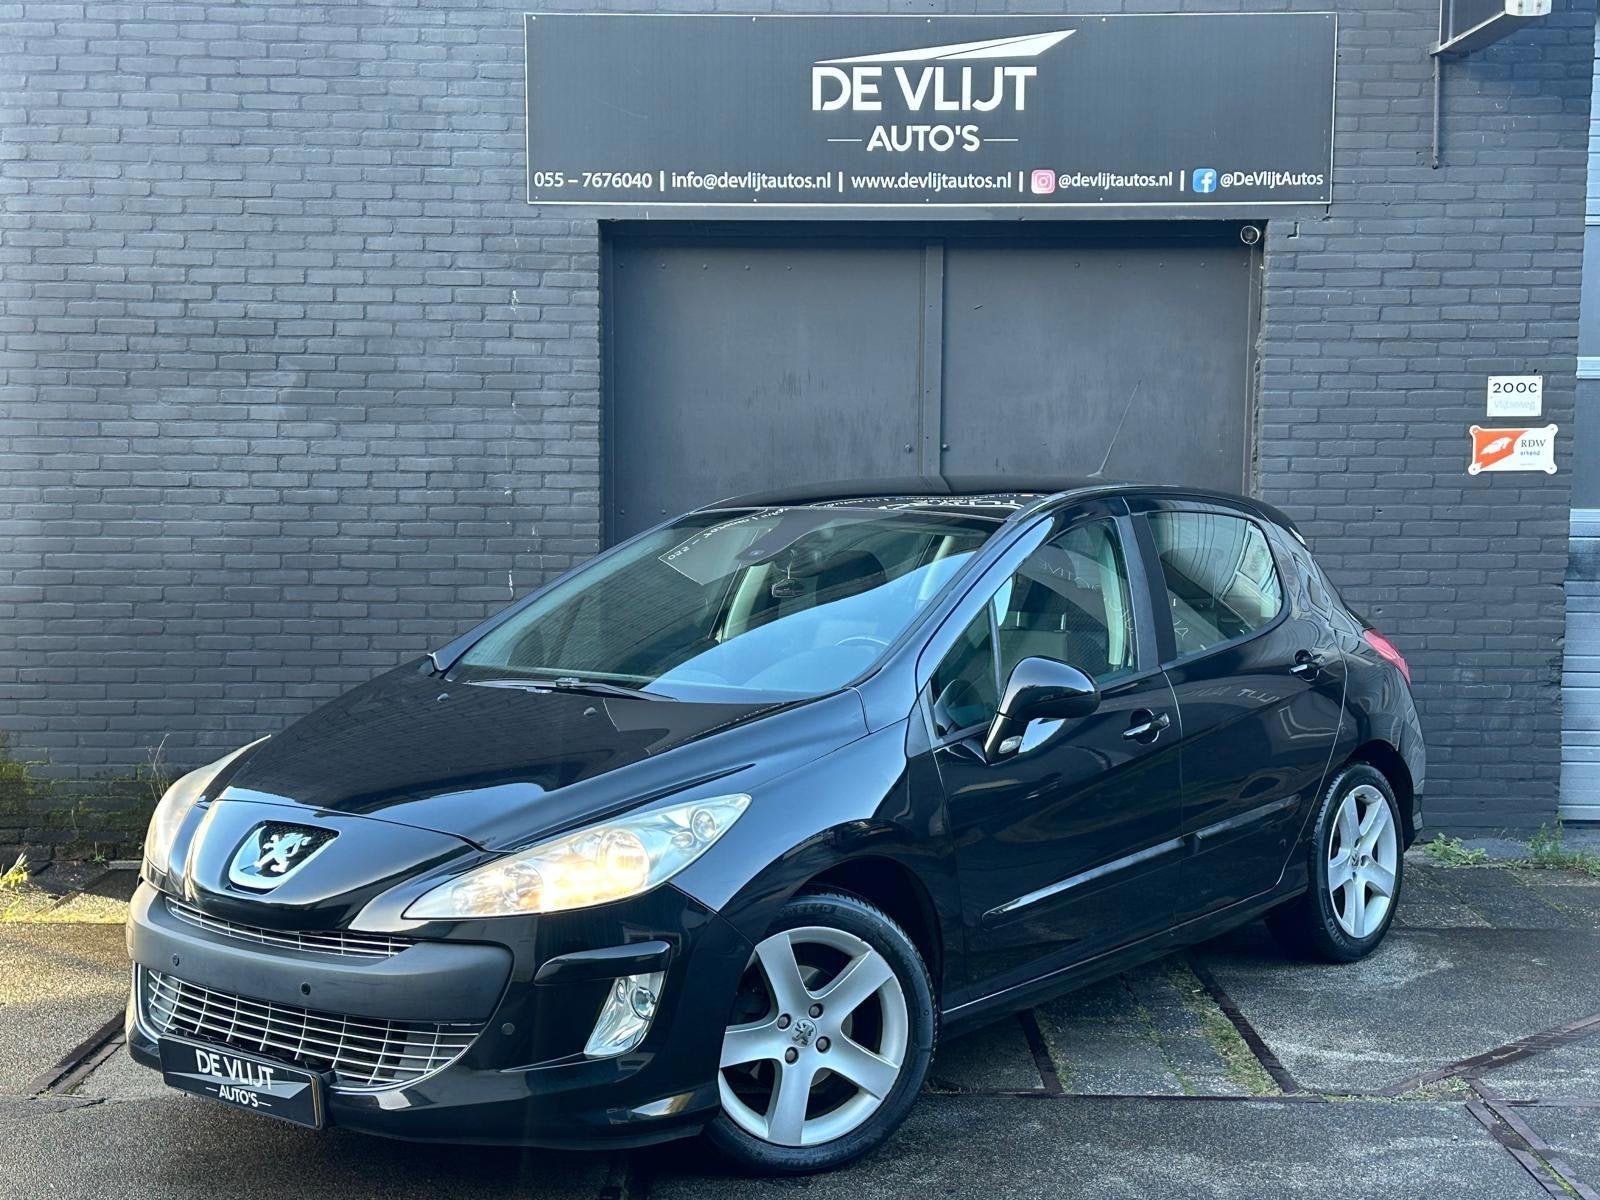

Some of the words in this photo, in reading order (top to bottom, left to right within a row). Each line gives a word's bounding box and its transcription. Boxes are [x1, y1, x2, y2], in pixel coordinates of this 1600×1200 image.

[812, 66, 882, 111] DE
[893, 66, 1037, 112] VLIJT
[866, 124, 980, 152] AUTO'S
[533, 171, 564, 188] 055
[582, 172, 653, 189] 7676040
[671, 171, 831, 192] info@devlijtautos.nl
[850, 171, 1012, 192] www.devlijtautos.nl
[1058, 171, 1173, 191] @devlijtautos.nl
[1219, 170, 1324, 190] @DeVlijtAutos
[1521, 439, 1546, 447] RDW
[195, 1049, 223, 1077] DE
[223, 1056, 274, 1090] VLIJT
[219, 1085, 259, 1108] AUTO'S
